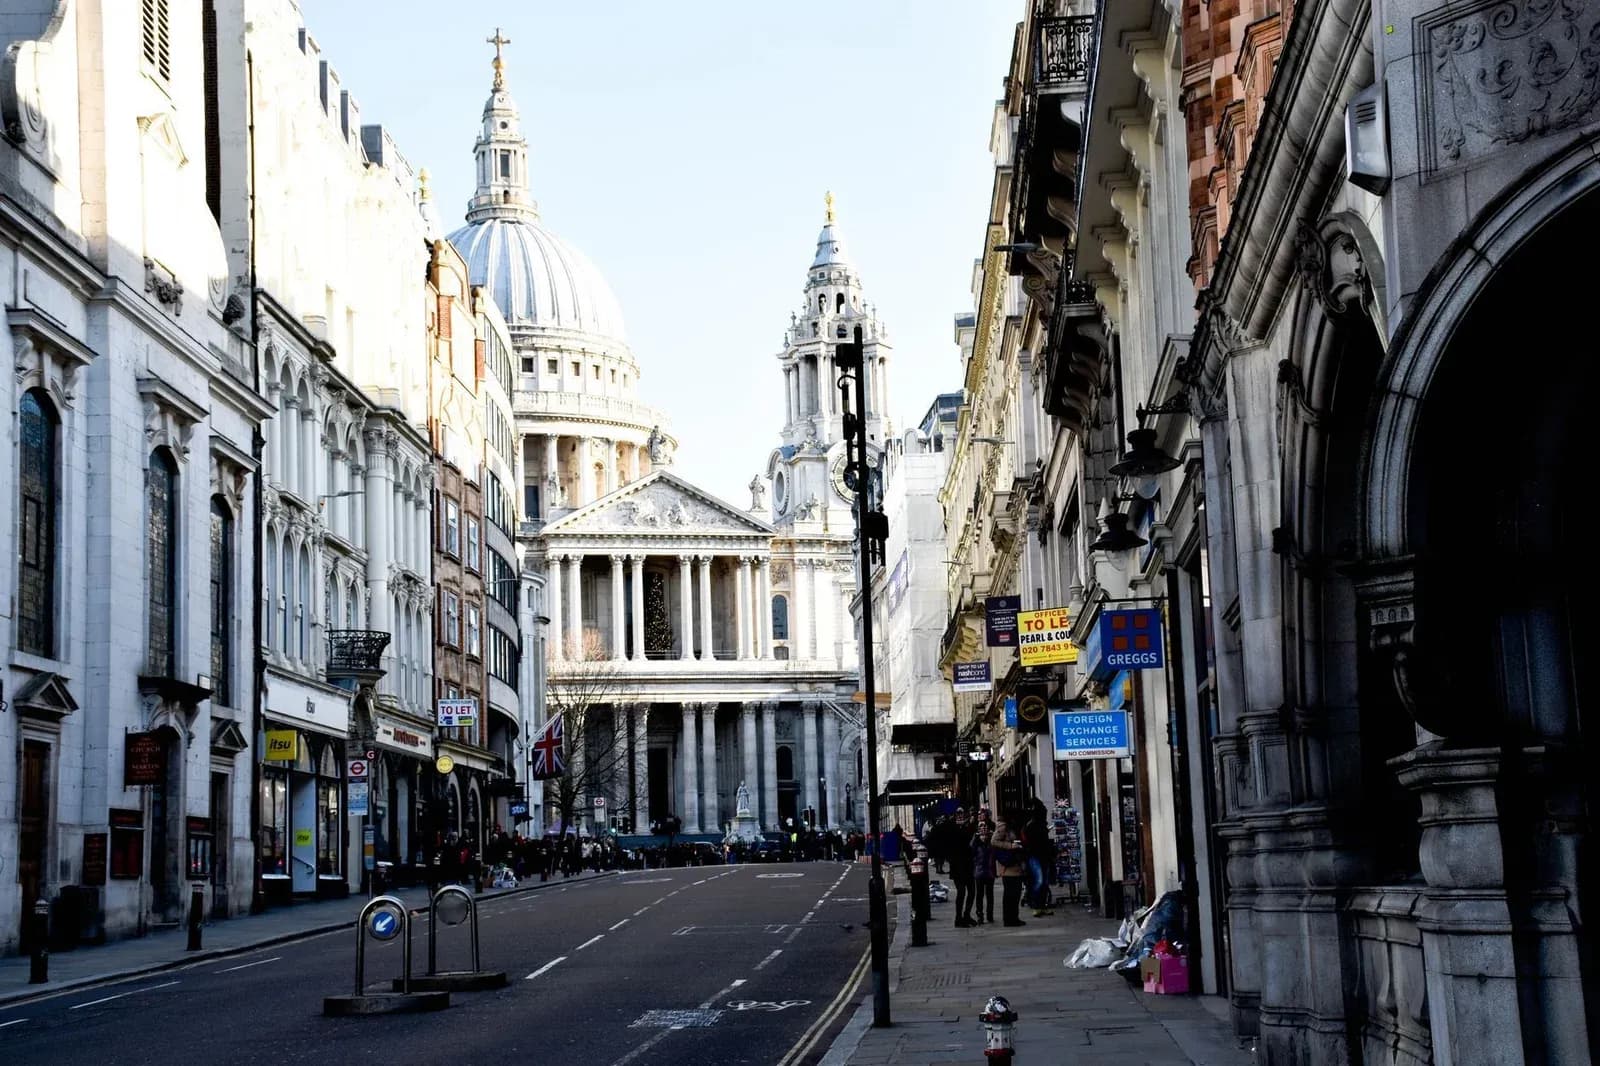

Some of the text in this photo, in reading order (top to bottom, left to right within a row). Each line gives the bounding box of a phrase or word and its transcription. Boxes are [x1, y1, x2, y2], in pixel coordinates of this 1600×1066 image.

[1034, 609, 1067, 619] OFFICES
[1024, 618, 1045, 632] TO
[1050, 616, 1069, 629] LE
[1020, 633, 1046, 645] PEARL
[1047, 631, 1054, 641] &
[1055, 629, 1072, 640] COU
[1022, 645, 1038, 655] 020
[1041, 643, 1062, 654] 7843
[1107, 652, 1158, 665] GREGGS
[958, 669, 986, 677] nashbond
[306, 696, 316, 714] itsu
[440, 706, 472, 715] TO LET
[1067, 714, 1113, 724] FOREIGN
[1062, 725, 1119, 736] EXCHANGE
[269, 738, 291, 750] itsu
[1066, 736, 1117, 747] SERVICES
[366, 750, 375, 759] G
